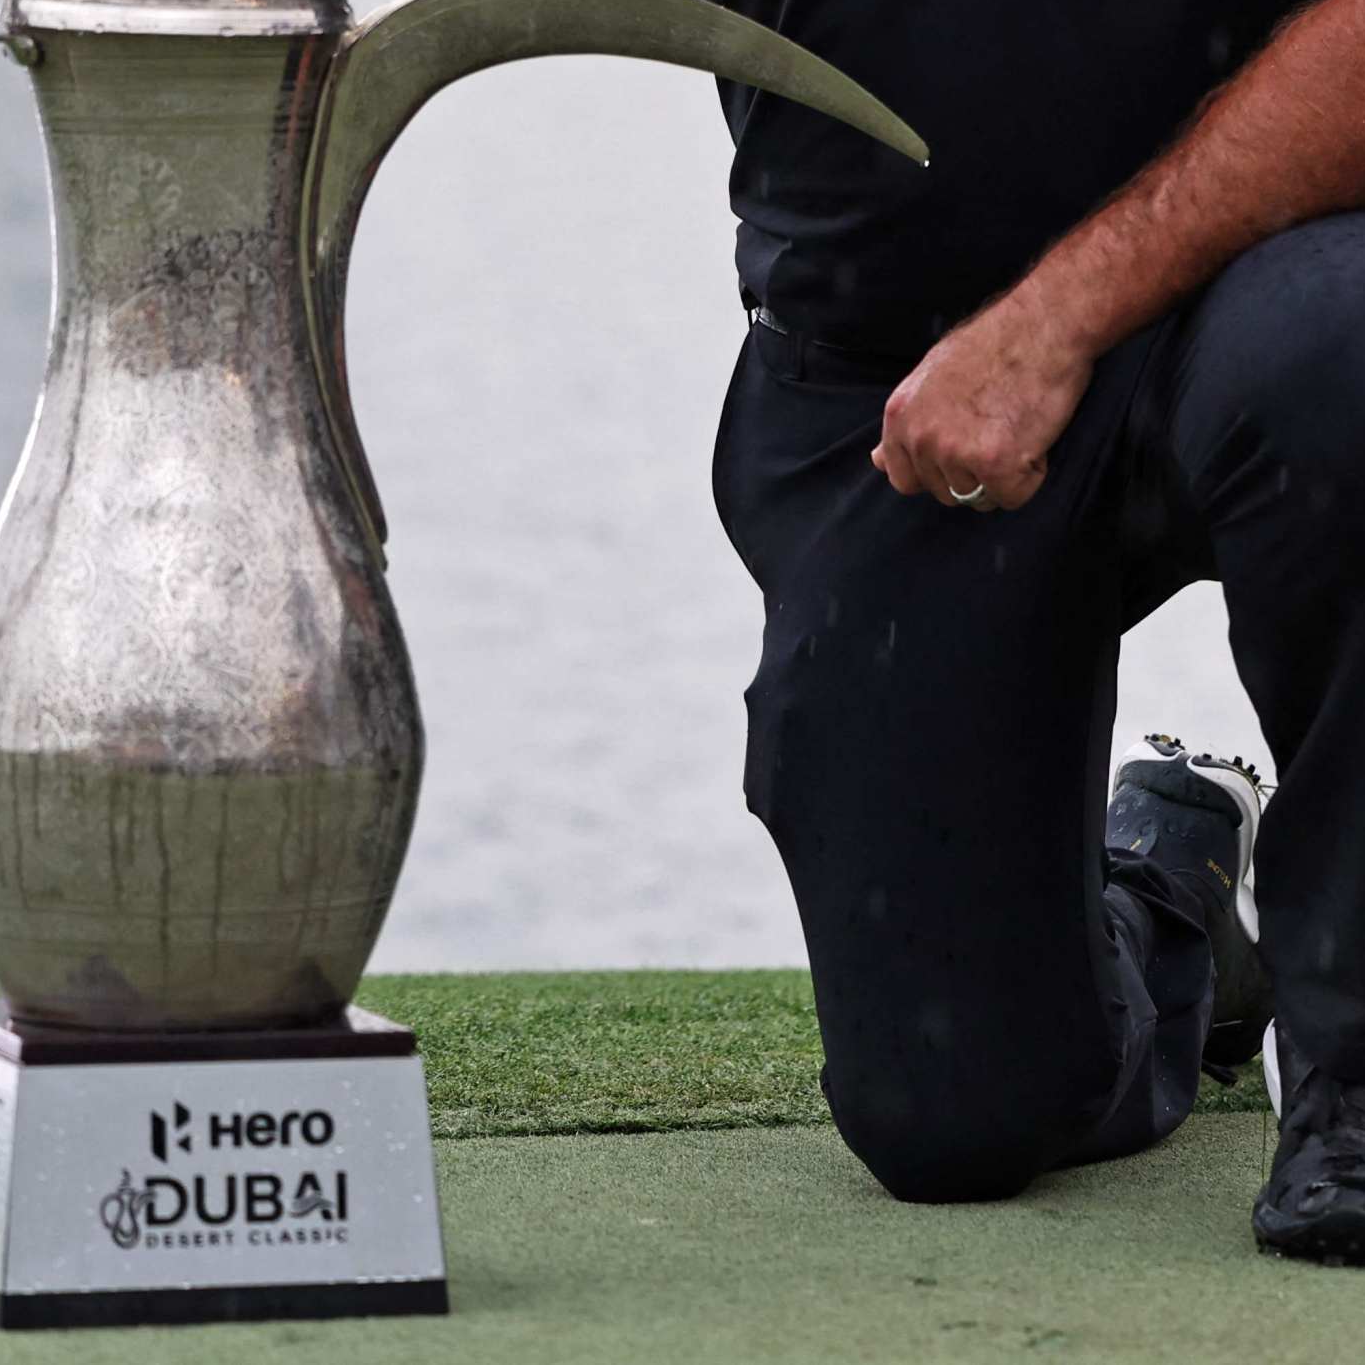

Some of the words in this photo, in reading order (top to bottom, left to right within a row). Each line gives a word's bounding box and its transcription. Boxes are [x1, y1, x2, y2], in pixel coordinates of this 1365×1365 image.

[208, 1110, 335, 1149] Hero
[144, 1170, 348, 1227] DUBAI
[144, 1229, 235, 1248] DESERT
[247, 1227, 350, 1246] CLASSIC
